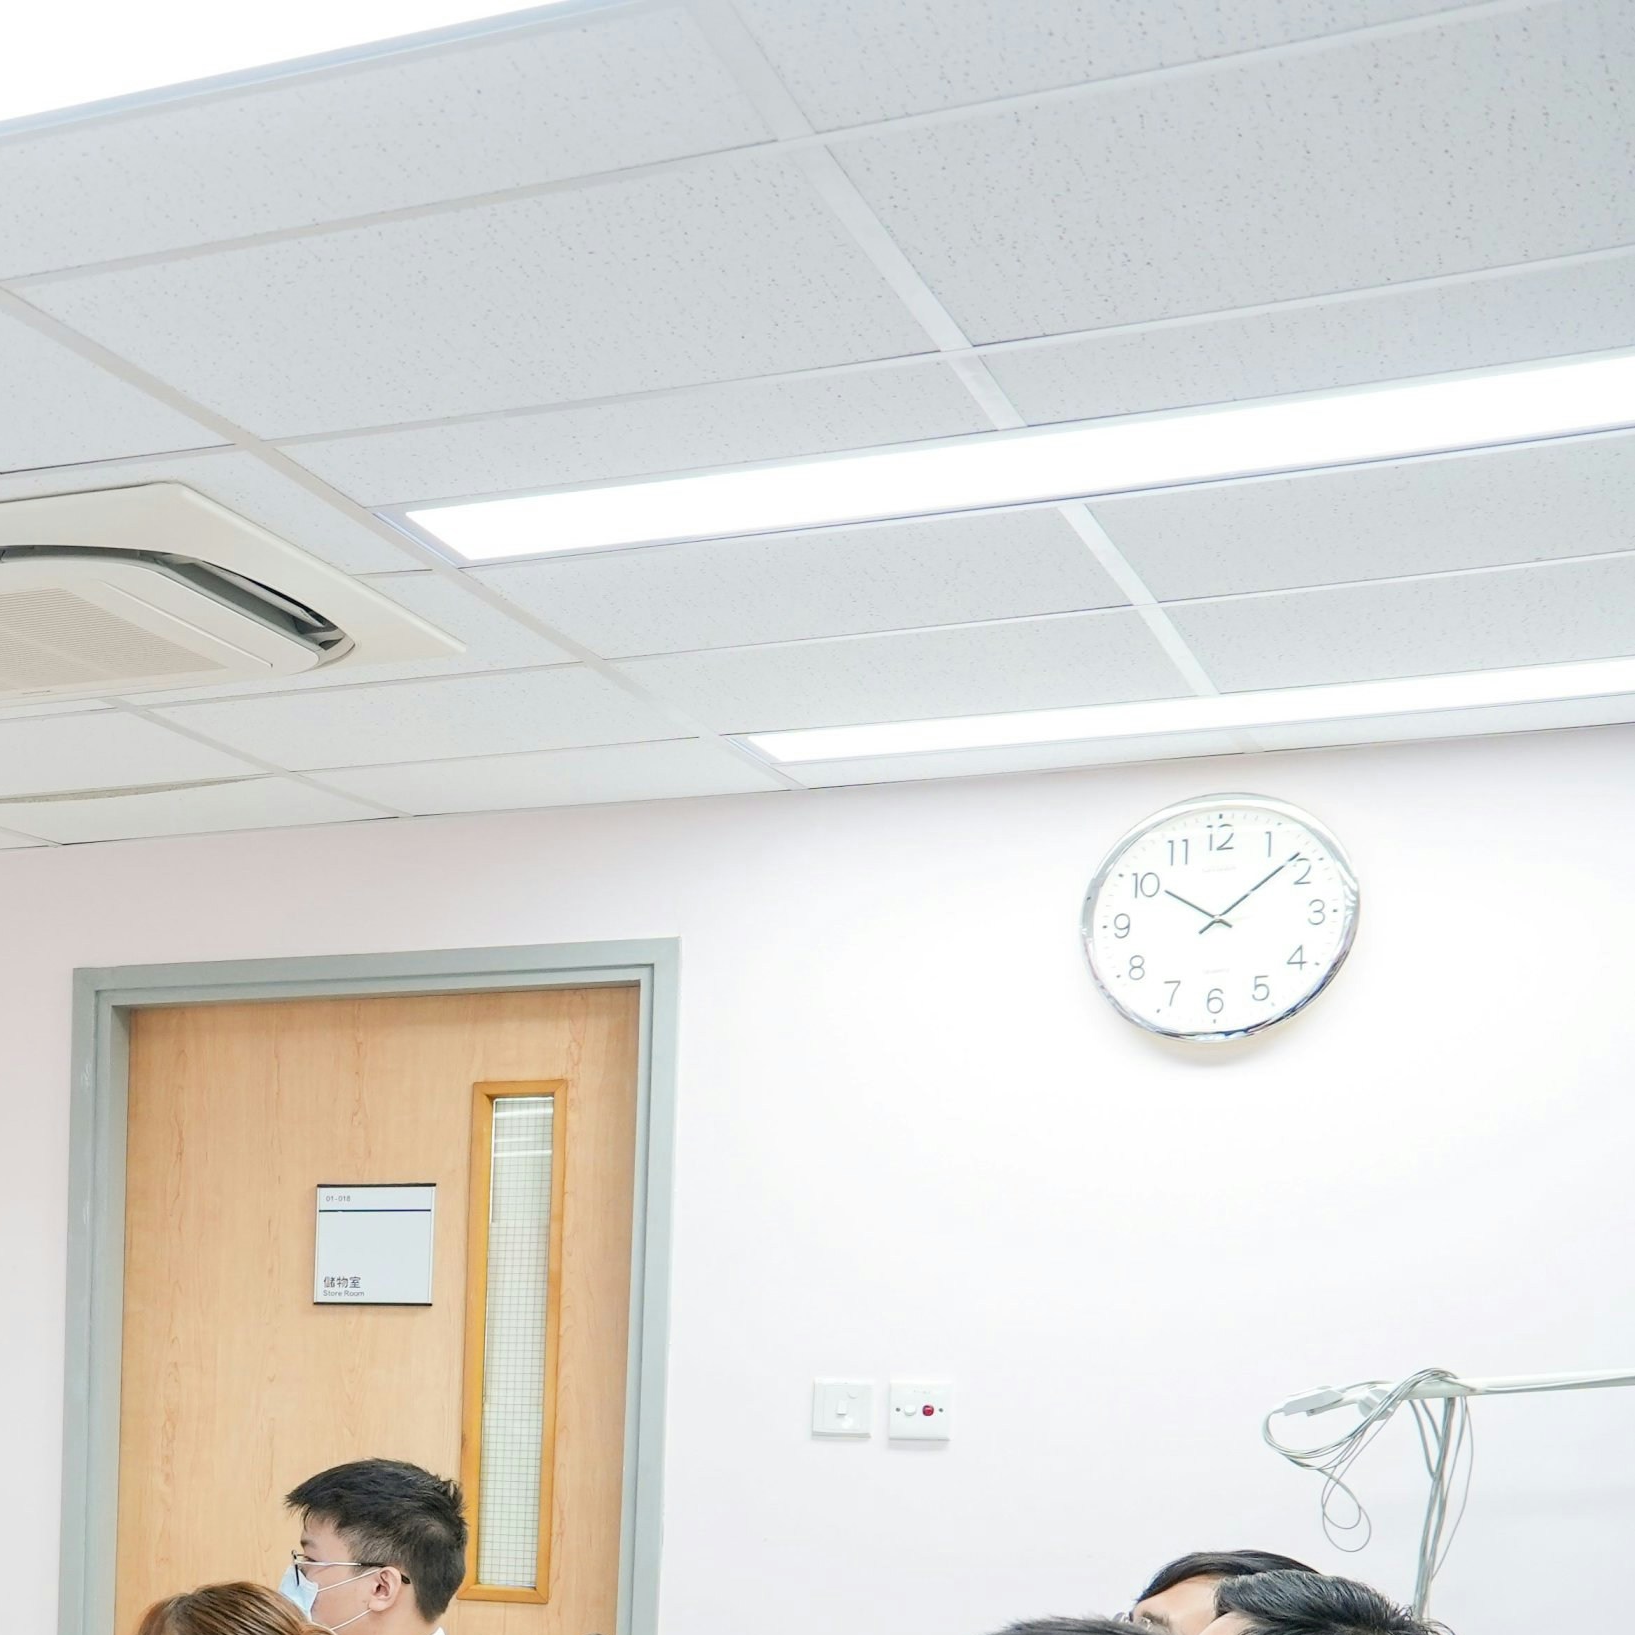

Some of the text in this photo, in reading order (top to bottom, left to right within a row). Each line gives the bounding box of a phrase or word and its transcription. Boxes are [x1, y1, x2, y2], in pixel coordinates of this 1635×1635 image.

[1206, 823, 1234, 851] 12
[1265, 831, 1272, 857] 1
[1167, 838, 1189, 866] 11
[1293, 858, 1312, 885] 2
[1131, 872, 1160, 898] 10
[1307, 899, 1326, 925] 3
[1113, 913, 1131, 939] 9
[1128, 955, 1145, 981] 8
[1286, 944, 1307, 970] 4
[1164, 980, 1181, 1007] 7
[1206, 988, 1224, 1014] 6
[1252, 975, 1270, 1002] 5
